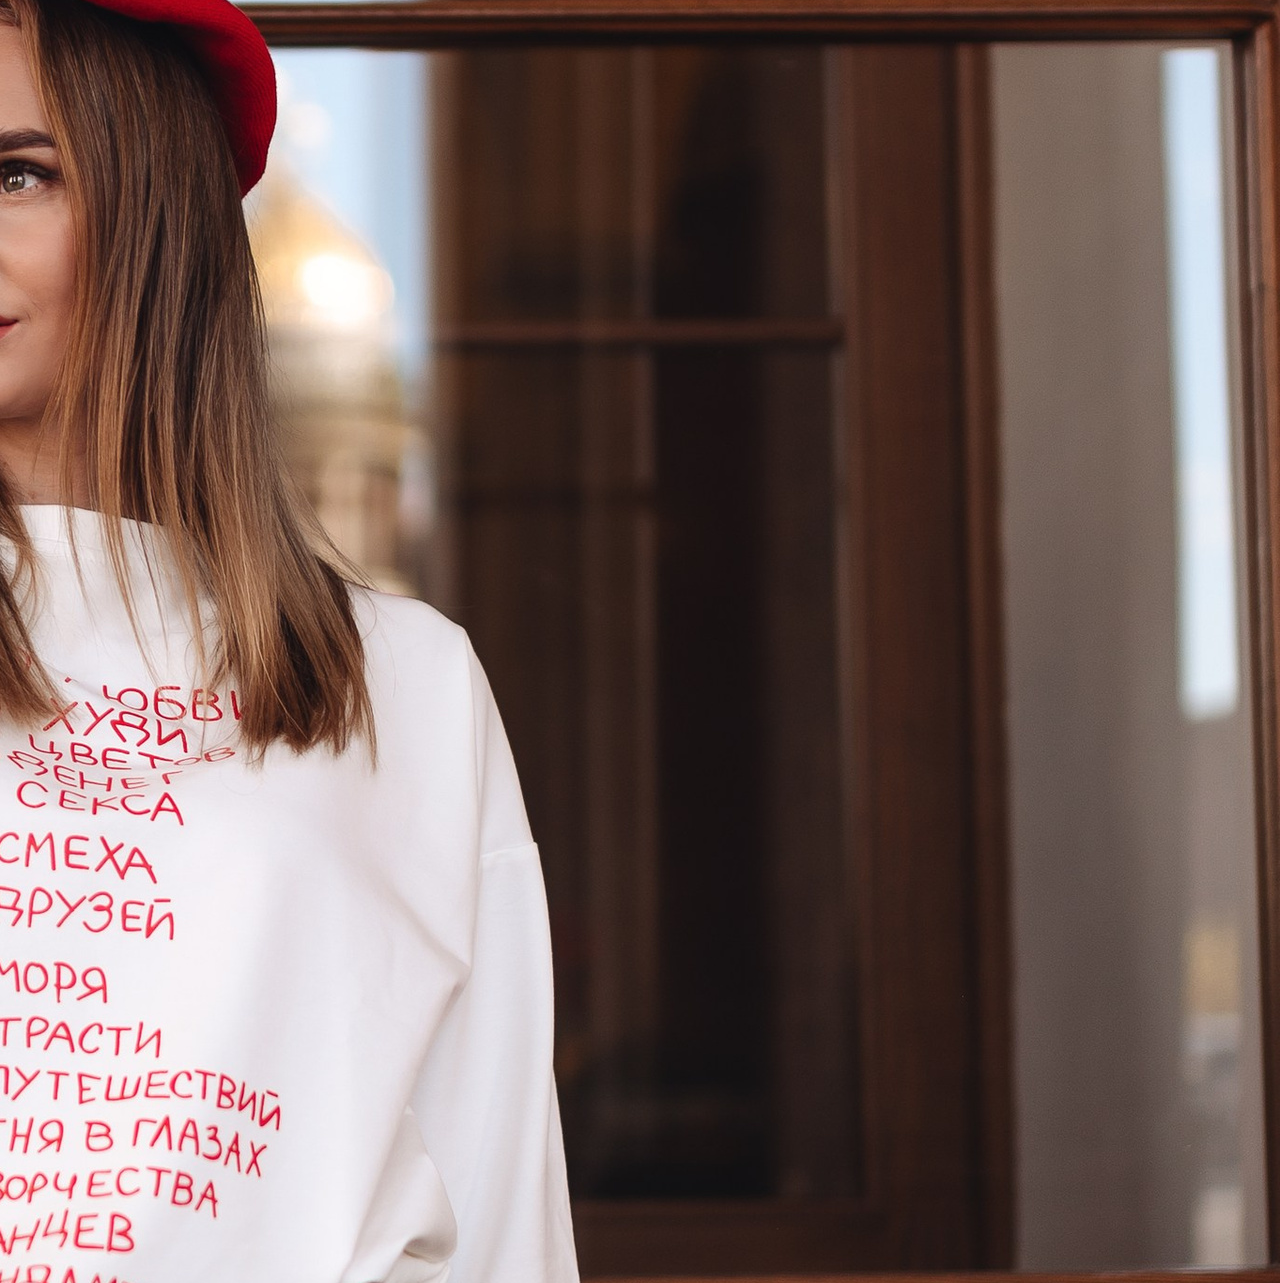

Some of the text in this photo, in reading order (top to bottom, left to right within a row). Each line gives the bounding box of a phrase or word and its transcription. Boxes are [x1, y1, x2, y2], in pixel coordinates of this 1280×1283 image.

[42, 697, 188, 754] ХУДИ
[7, 749, 184, 793] ДЕНЕГ
[28, 733, 237, 771] ЦВЕТОВ
[15, 779, 185, 827] СЕКСА
[84, 1119, 115, 1153] В
[131, 1114, 268, 1179] ГЛАЗАХ
